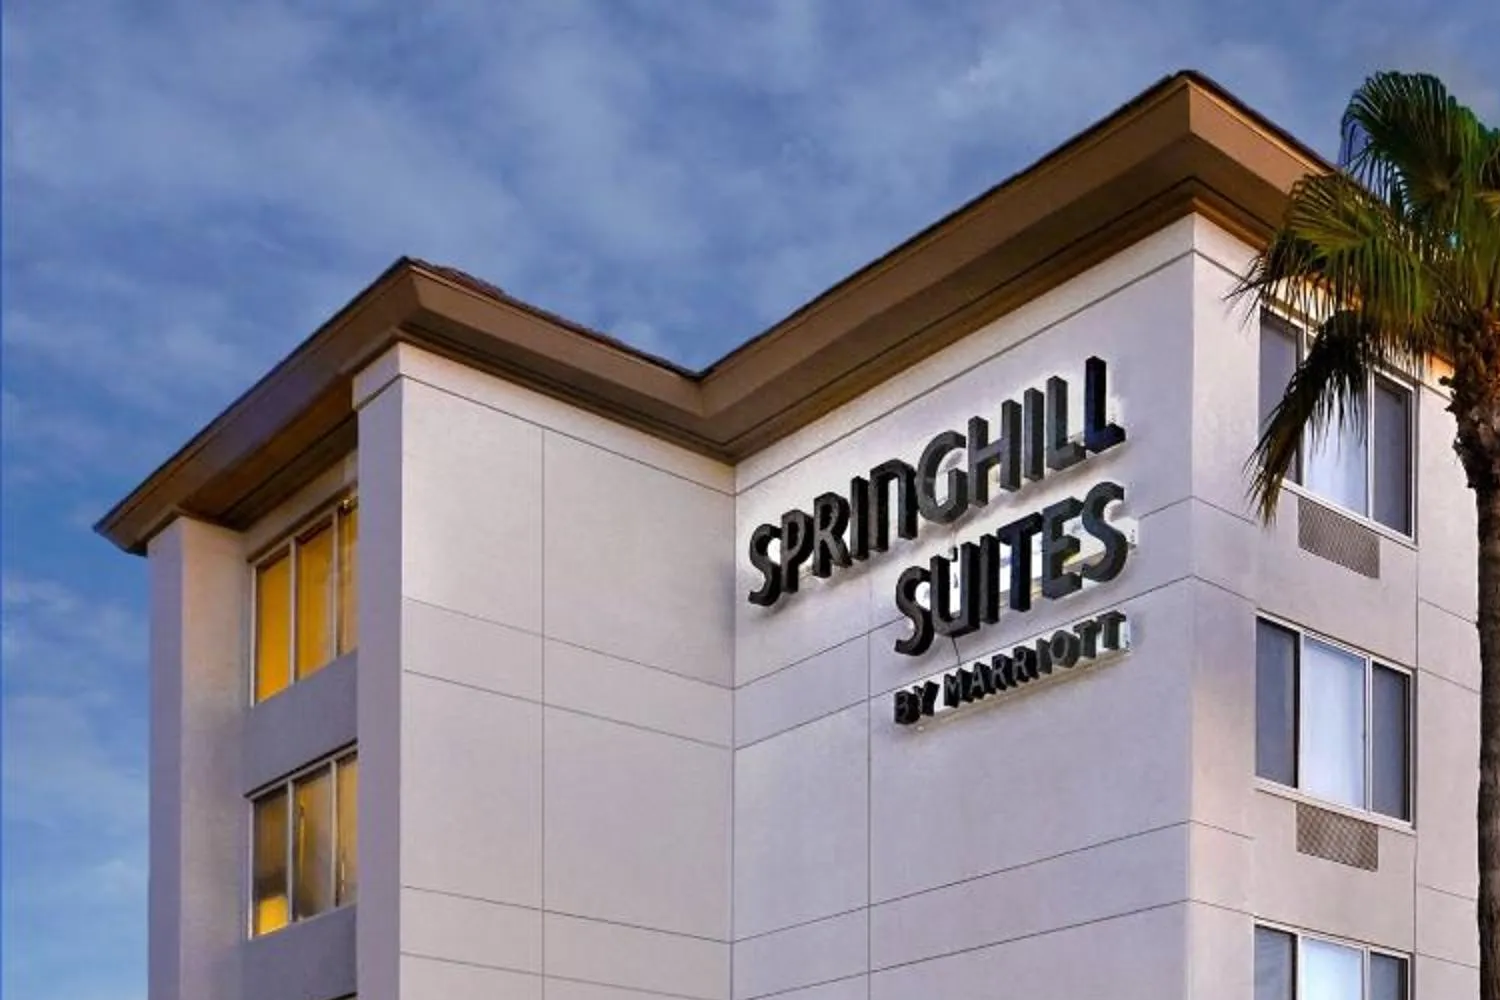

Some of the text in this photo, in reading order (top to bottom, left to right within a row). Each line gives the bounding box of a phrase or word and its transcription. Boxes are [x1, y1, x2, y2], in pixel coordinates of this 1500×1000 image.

[748, 355, 1126, 607] SPRINGHILL
[894, 481, 1128, 656] SUITES
[894, 610, 1127, 725] BY MARRIOTT
